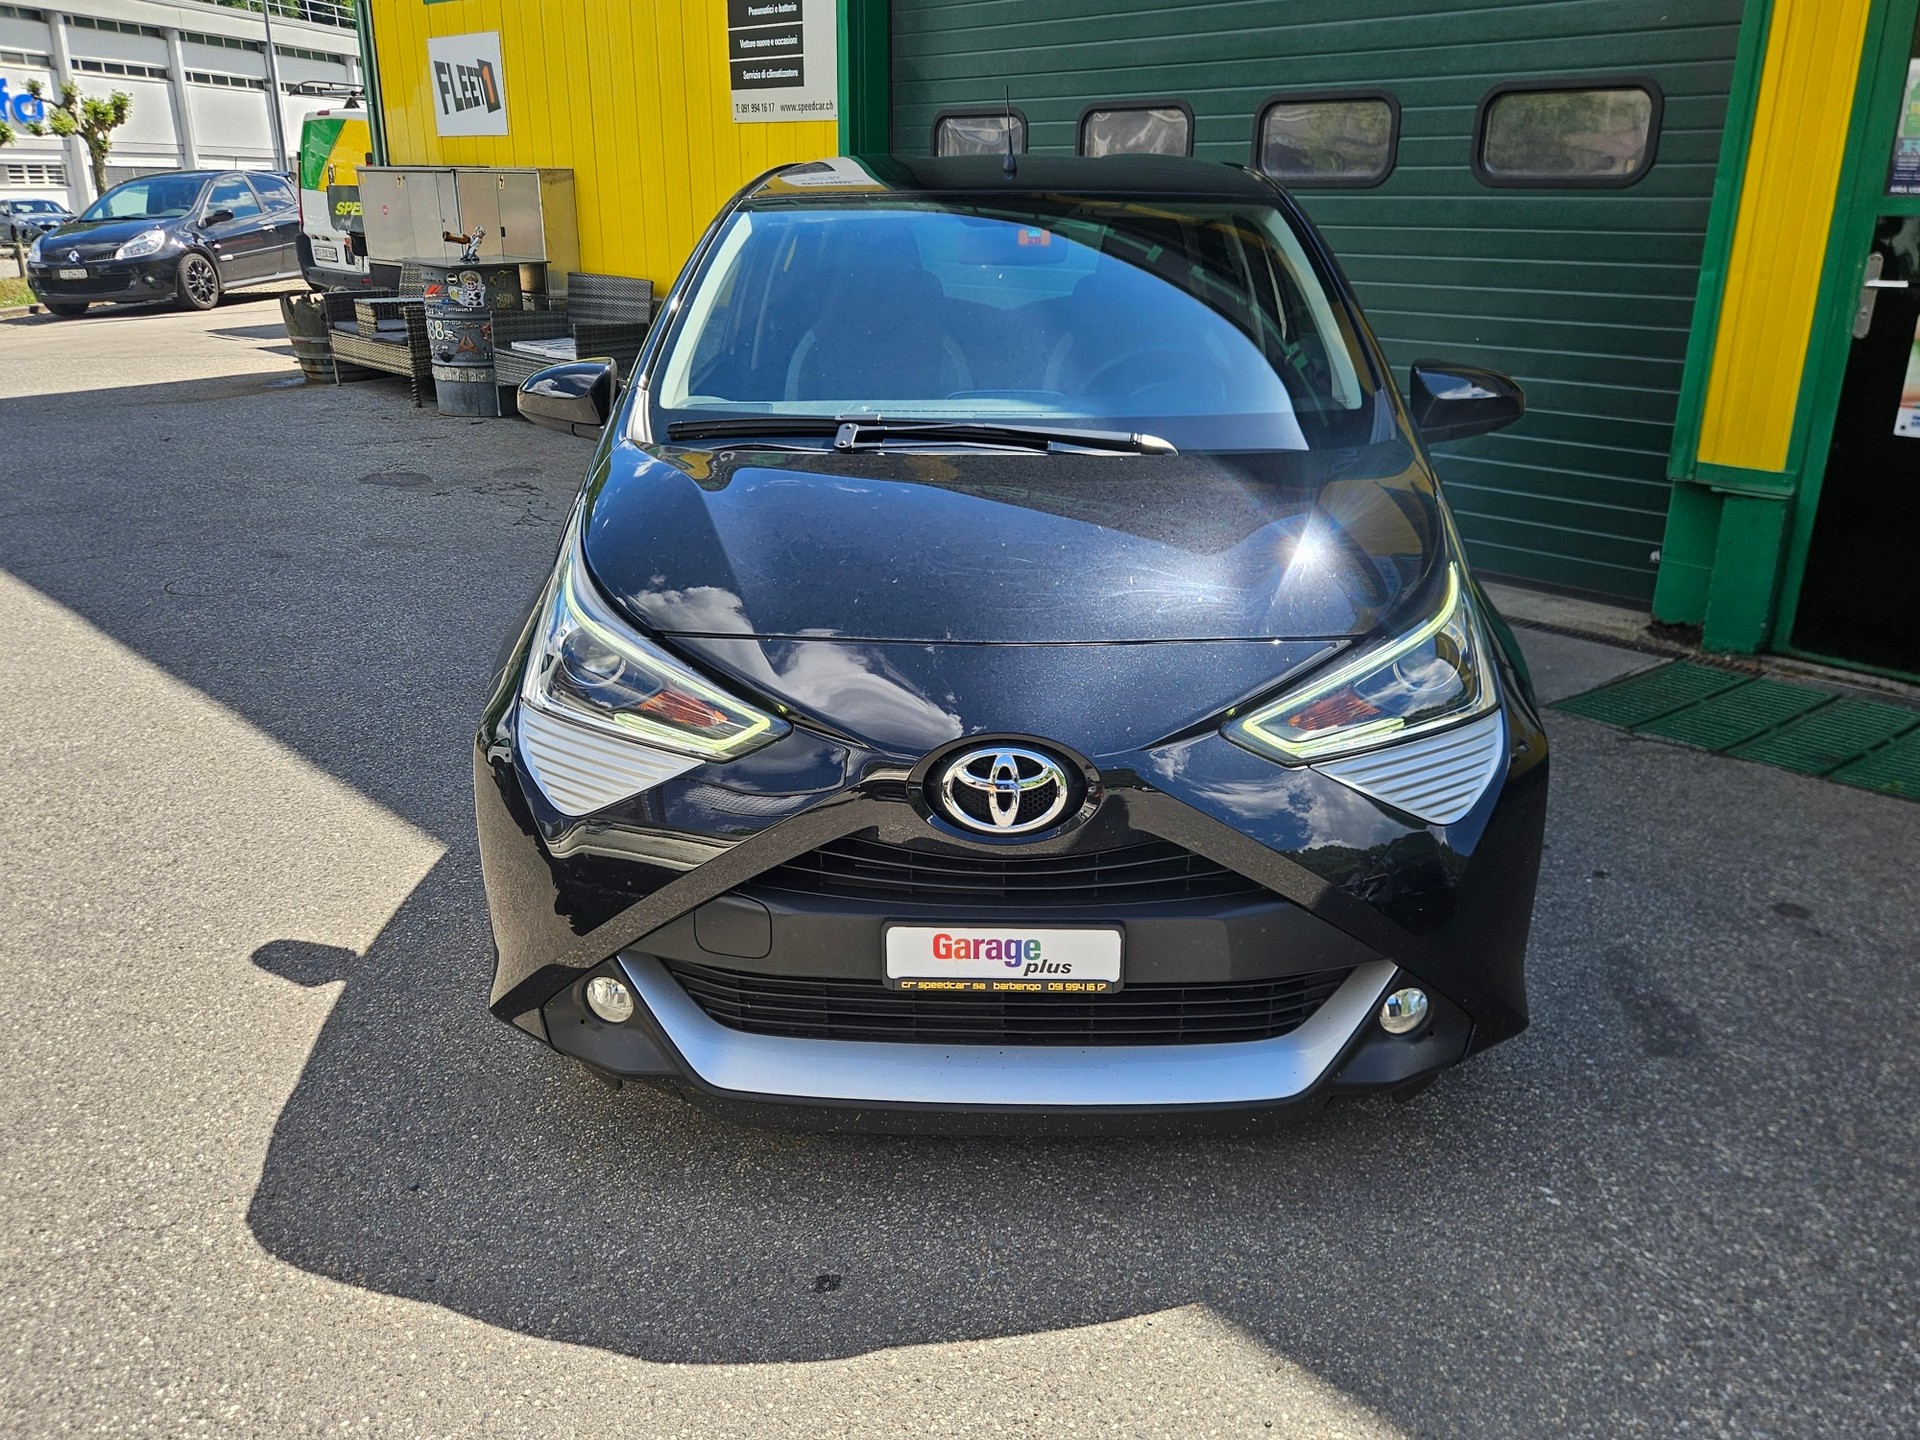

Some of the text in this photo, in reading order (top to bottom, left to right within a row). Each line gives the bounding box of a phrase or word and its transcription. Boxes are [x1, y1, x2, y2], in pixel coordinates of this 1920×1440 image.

[748, 4, 774, 16] Pneumatici
[778, 3, 797, 13] batterie
[739, 39, 756, 49] Vetture
[756, 39, 771, 48] nuove
[775, 35, 798, 45] occasioni
[743, 68, 799, 80] Servizio di climatizzatore
[741, 103, 750, 113] 091
[751, 103, 760, 113] 994
[761, 103, 768, 113] 16
[768, 103, 775, 112] 17
[780, 100, 834, 114] www.speedcar.ch
[335, 201, 363, 216] SPE
[932, 933, 1041, 968] Garage
[1023, 959, 1072, 977] plus
[917, 981, 972, 990] speedcar
[972, 982, 986, 990] sa
[993, 982, 1042, 992] barbengo
[1048, 983, 1064, 991] 091
[1064, 983, 1086, 991] 994
[1086, 983, 1096, 991] 16
